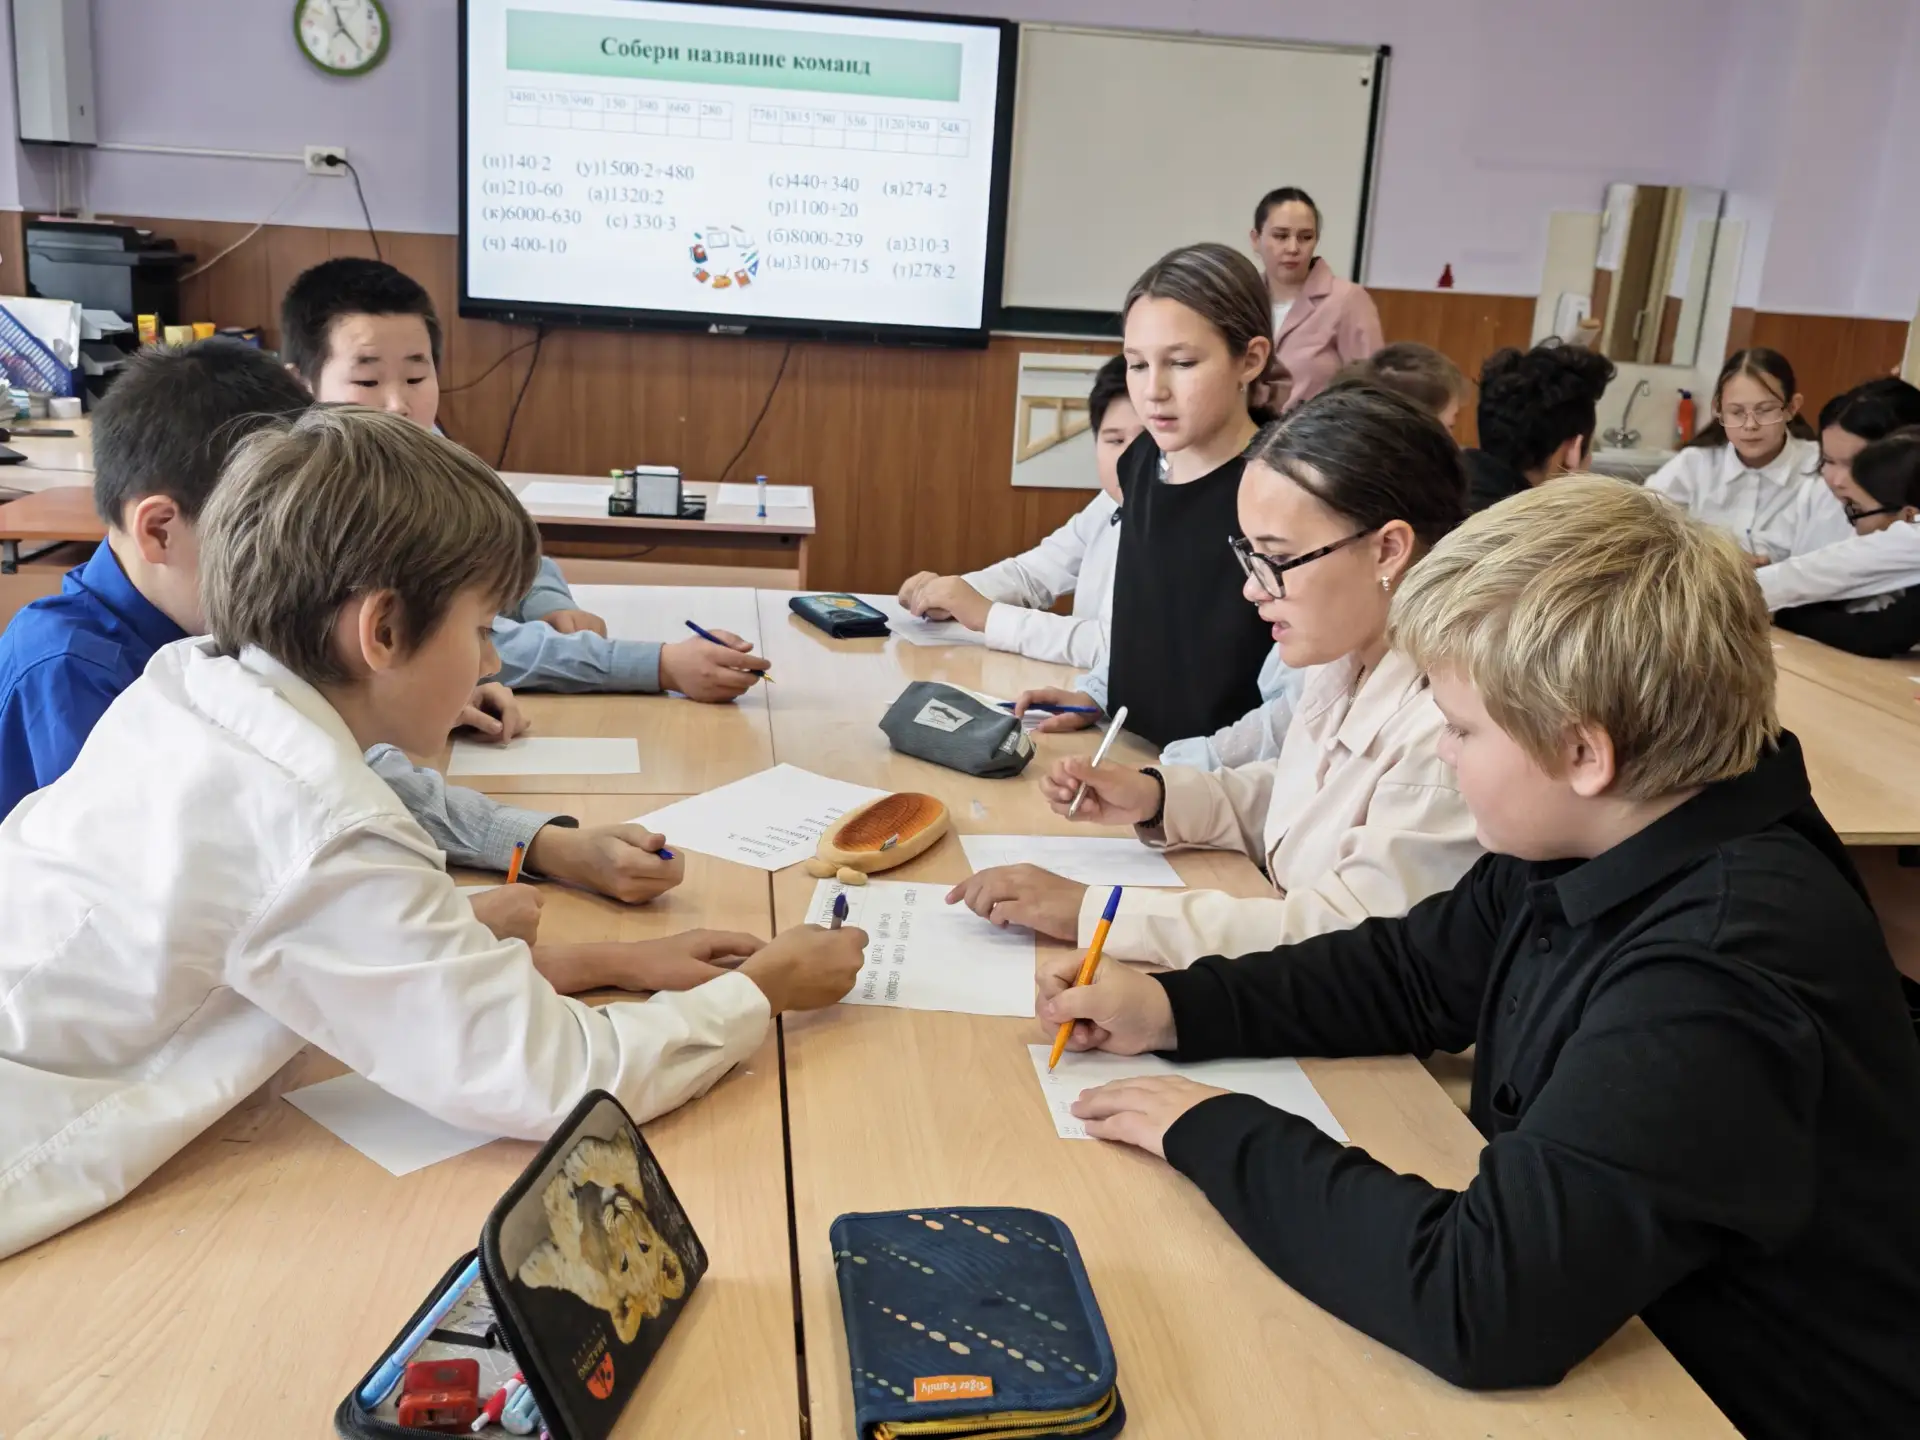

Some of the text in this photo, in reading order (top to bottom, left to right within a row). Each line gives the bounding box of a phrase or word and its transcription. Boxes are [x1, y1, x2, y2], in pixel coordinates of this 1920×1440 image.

[600, 36, 871, 76] Собери название команд
[920, 1381, 958, 1396] Family
